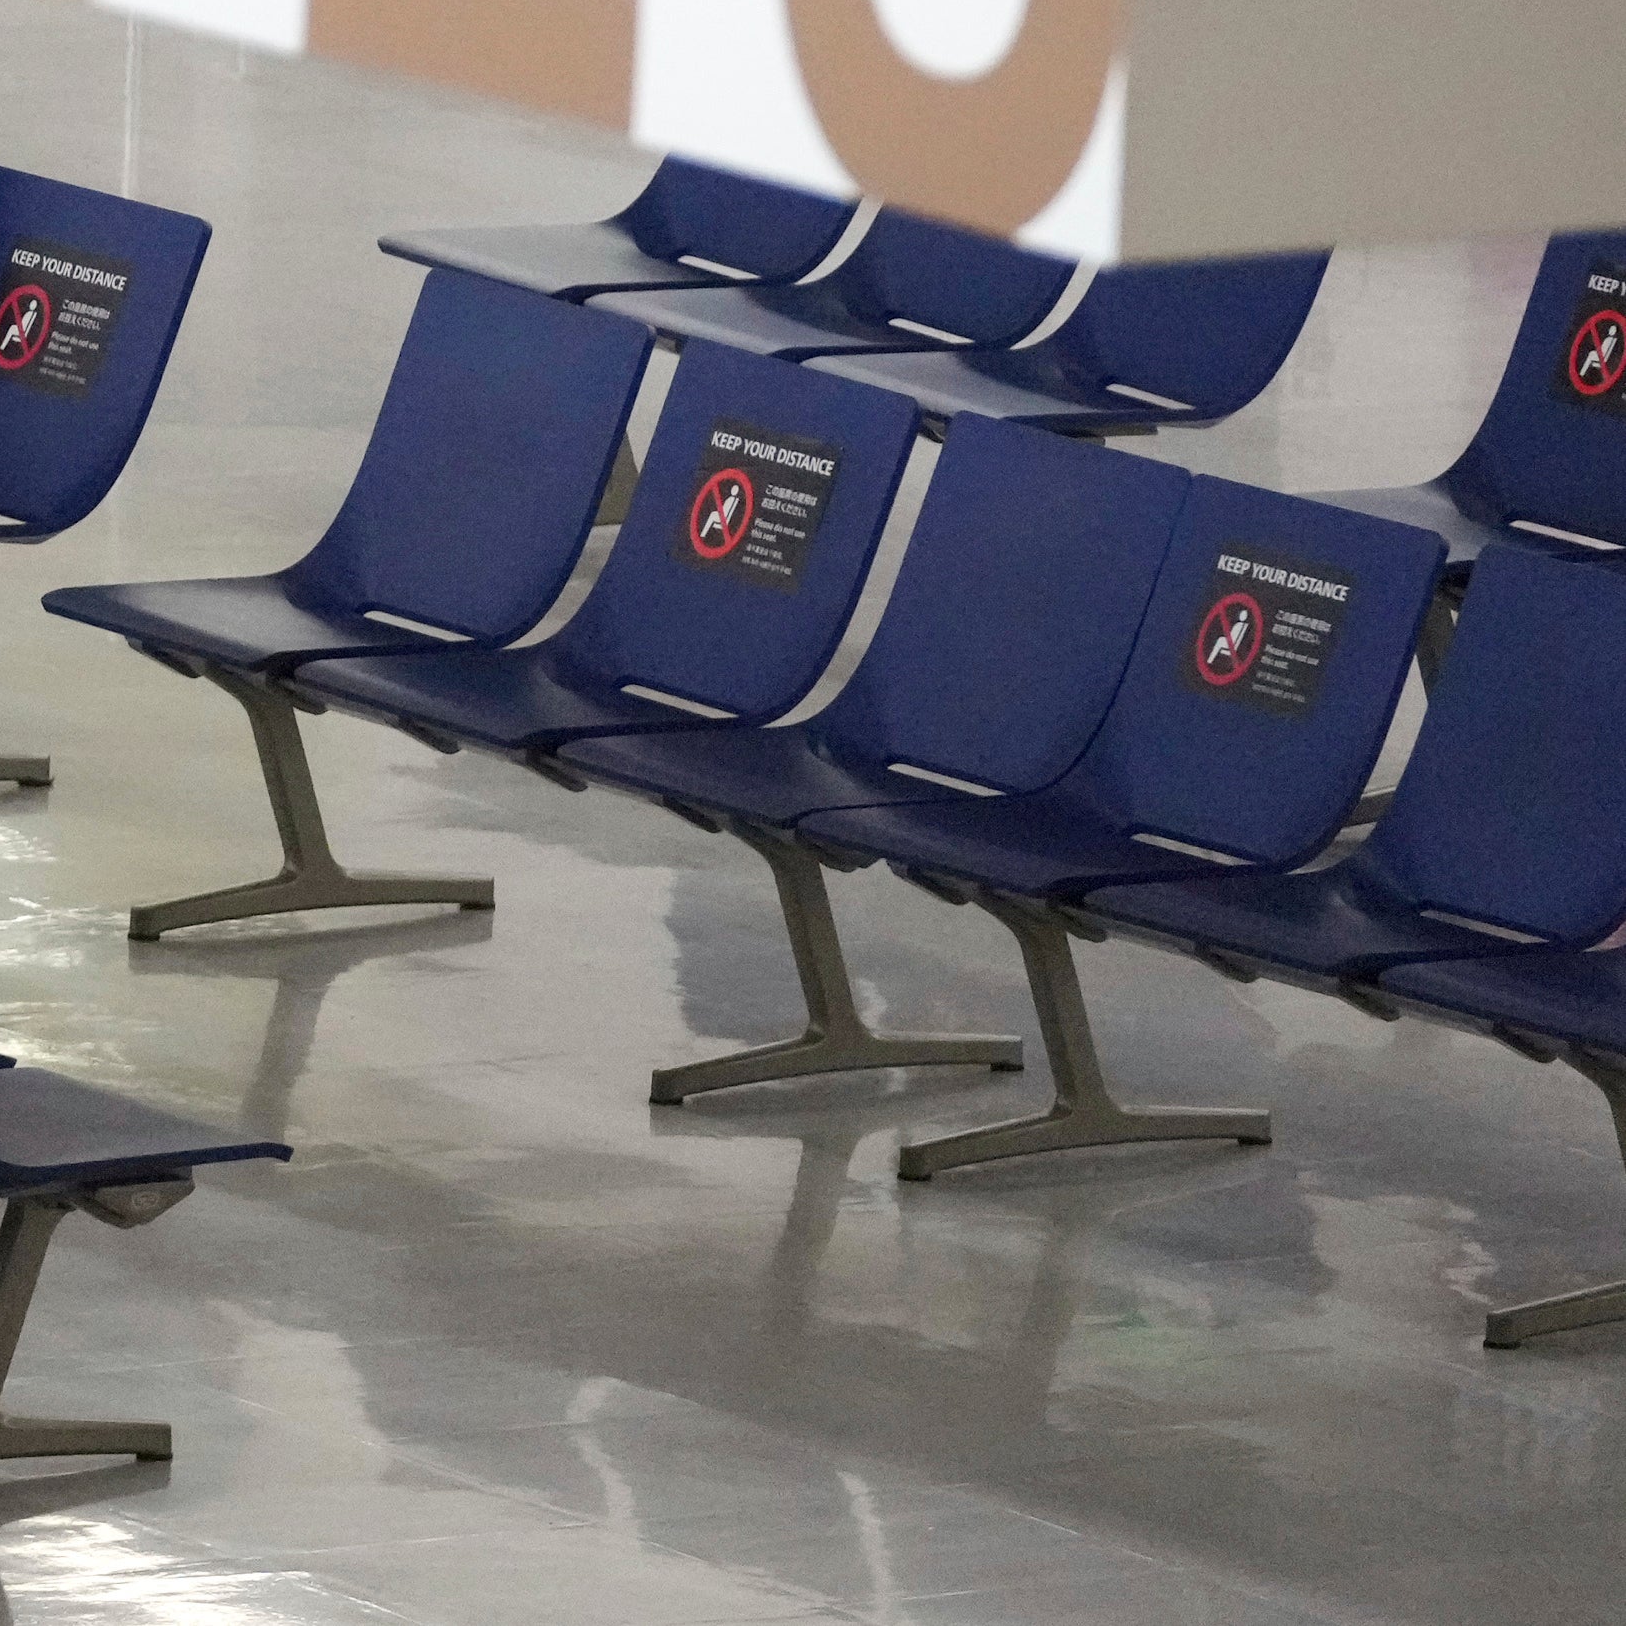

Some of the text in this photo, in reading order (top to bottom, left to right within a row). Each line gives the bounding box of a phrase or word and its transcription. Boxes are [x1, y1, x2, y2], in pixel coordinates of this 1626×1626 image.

[11, 249, 127, 291] KEEP YOUR DISTANCE
[1587, 274, 1619, 293] KEEP
[711, 431, 834, 477] KEEP YOUR DISTANCE
[1217, 554, 1350, 601] KEEP YOUR DISTANCE
